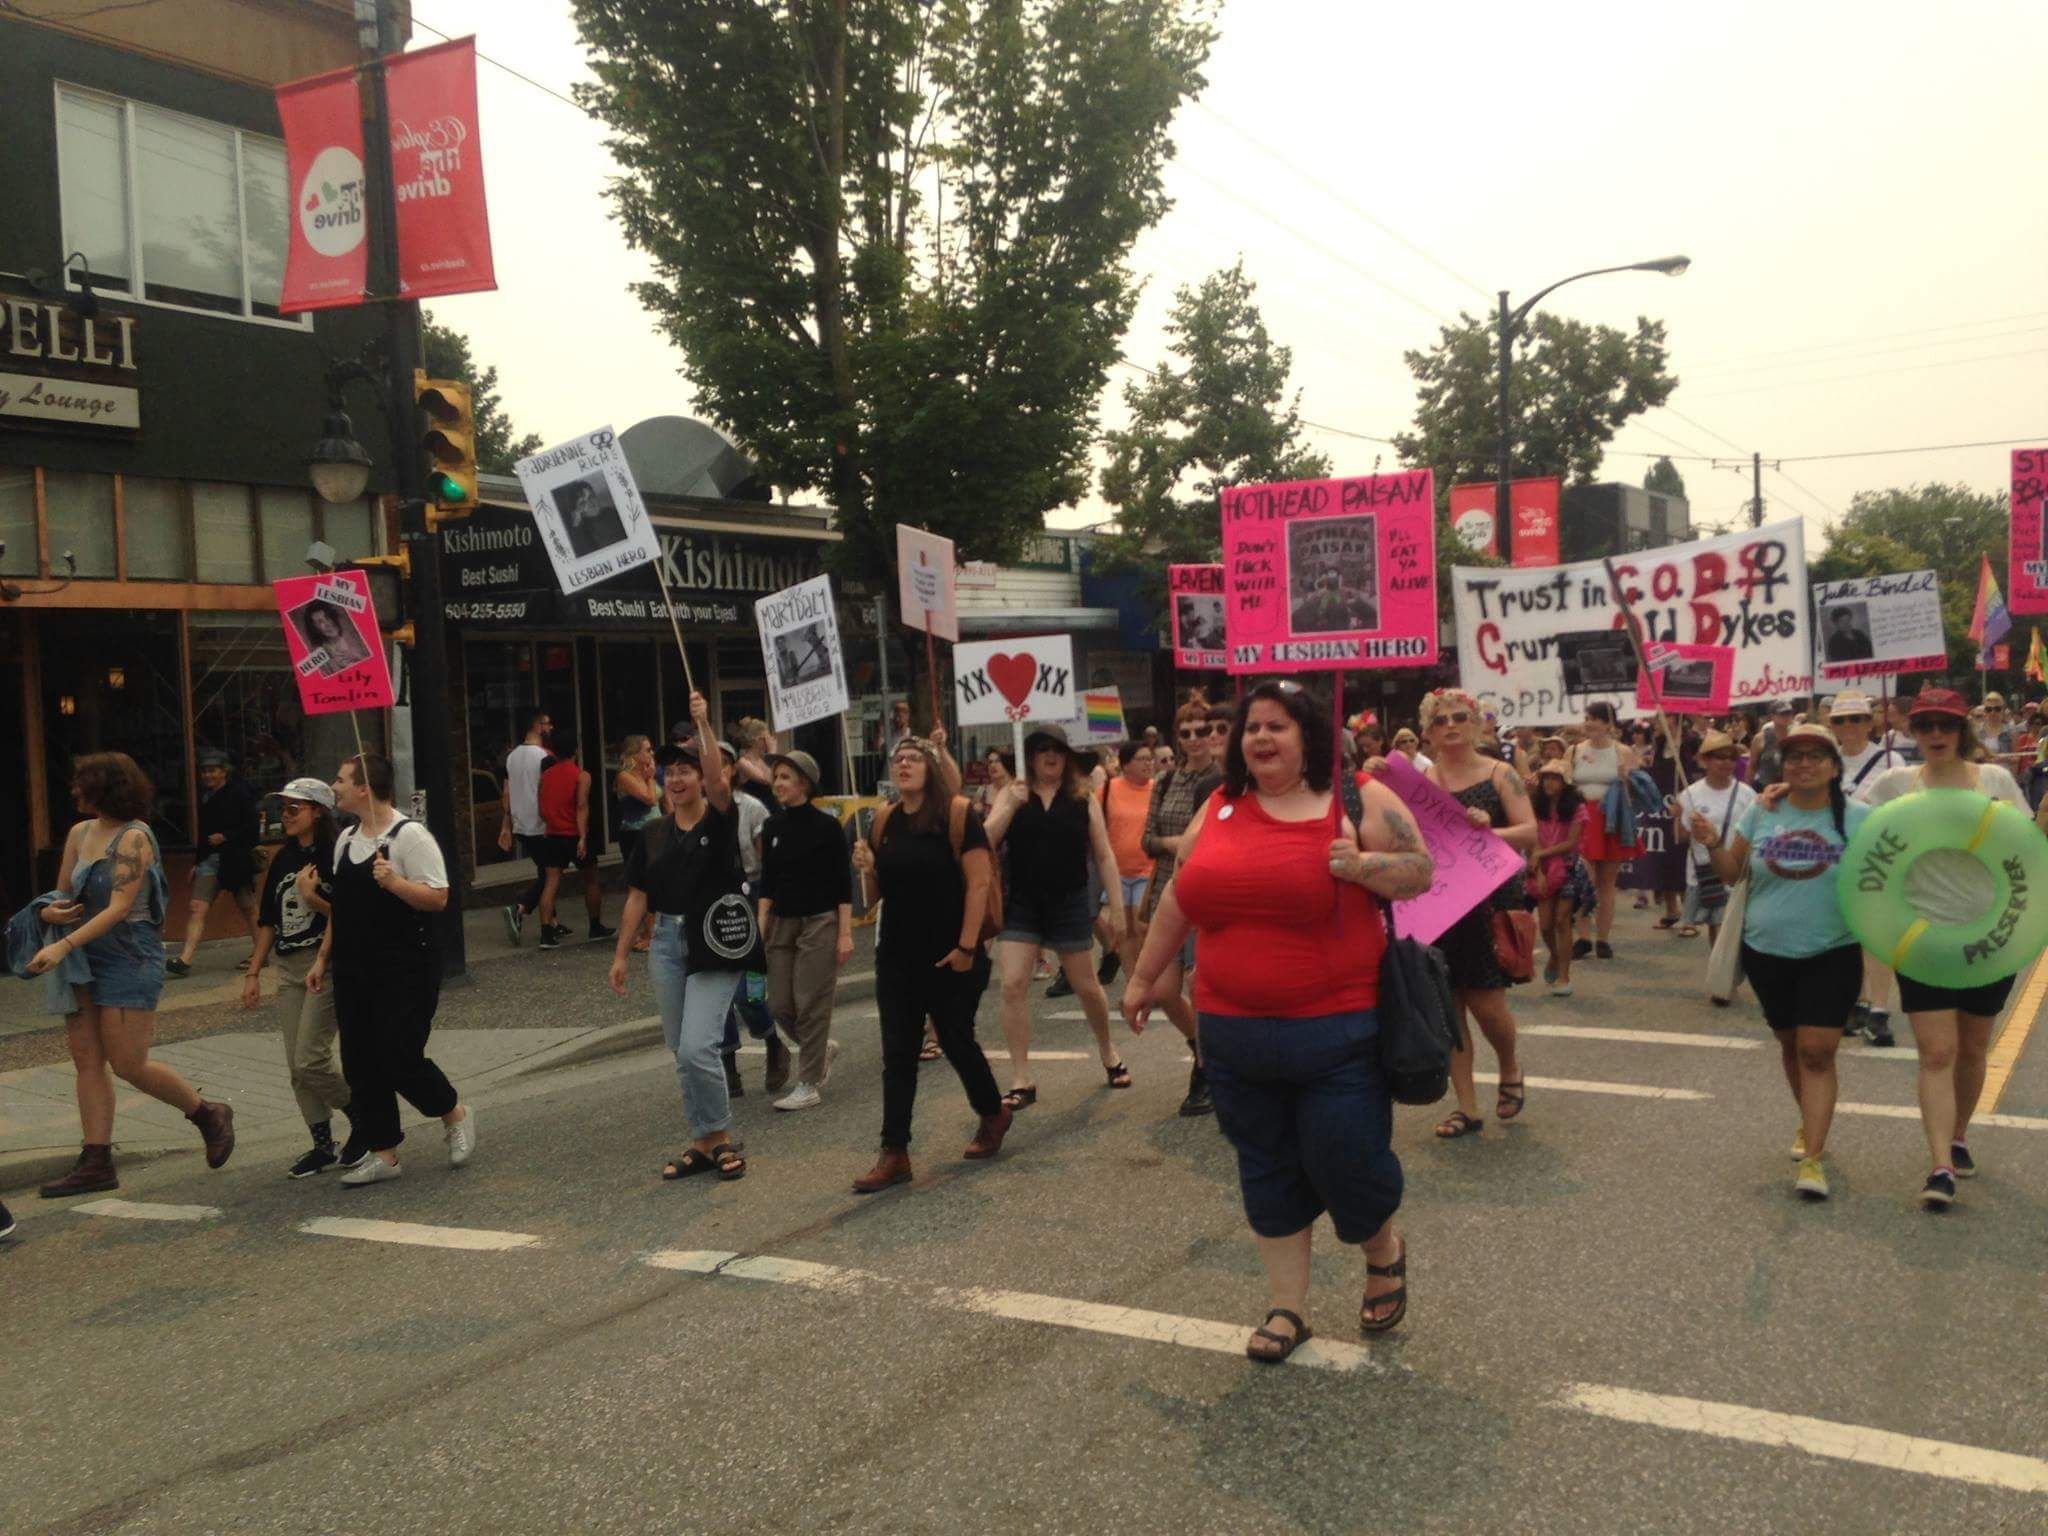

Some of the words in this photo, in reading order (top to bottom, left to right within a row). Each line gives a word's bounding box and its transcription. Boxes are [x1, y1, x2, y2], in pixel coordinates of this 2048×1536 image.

[18, 382, 118, 418] Lounge
[577, 450, 610, 472] RICH
[1223, 485, 1330, 522] HOTHEAD
[1341, 471, 1427, 512] PAISAN
[443, 523, 533, 554] Kishimoto
[1389, 542, 1419, 558] EAT
[616, 546, 647, 569] HERO
[335, 577, 352, 592] MY
[461, 567, 487, 587] Best
[488, 562, 520, 585] Sushi
[317, 587, 363, 611] LESBIAN
[1466, 571, 1572, 619] Trust
[1580, 577, 1607, 609] in
[1815, 581, 1860, 606] Julie
[1864, 571, 1938, 598] Bindel
[587, 598, 616, 617] Best
[616, 599, 646, 617] Sushi
[650, 601, 669, 618] Eat
[692, 606, 713, 623] your
[1688, 596, 1796, 649] Dykes
[299, 651, 328, 674] HERO
[1233, 645, 1263, 664] MY
[1271, 639, 1360, 662] LESBIAN
[1366, 636, 1427, 658] HERO
[337, 670, 371, 687] Lily
[310, 688, 379, 705] Tomlin
[1858, 829, 1909, 893] DYKE
[1963, 853, 2029, 966] PRESERVER
